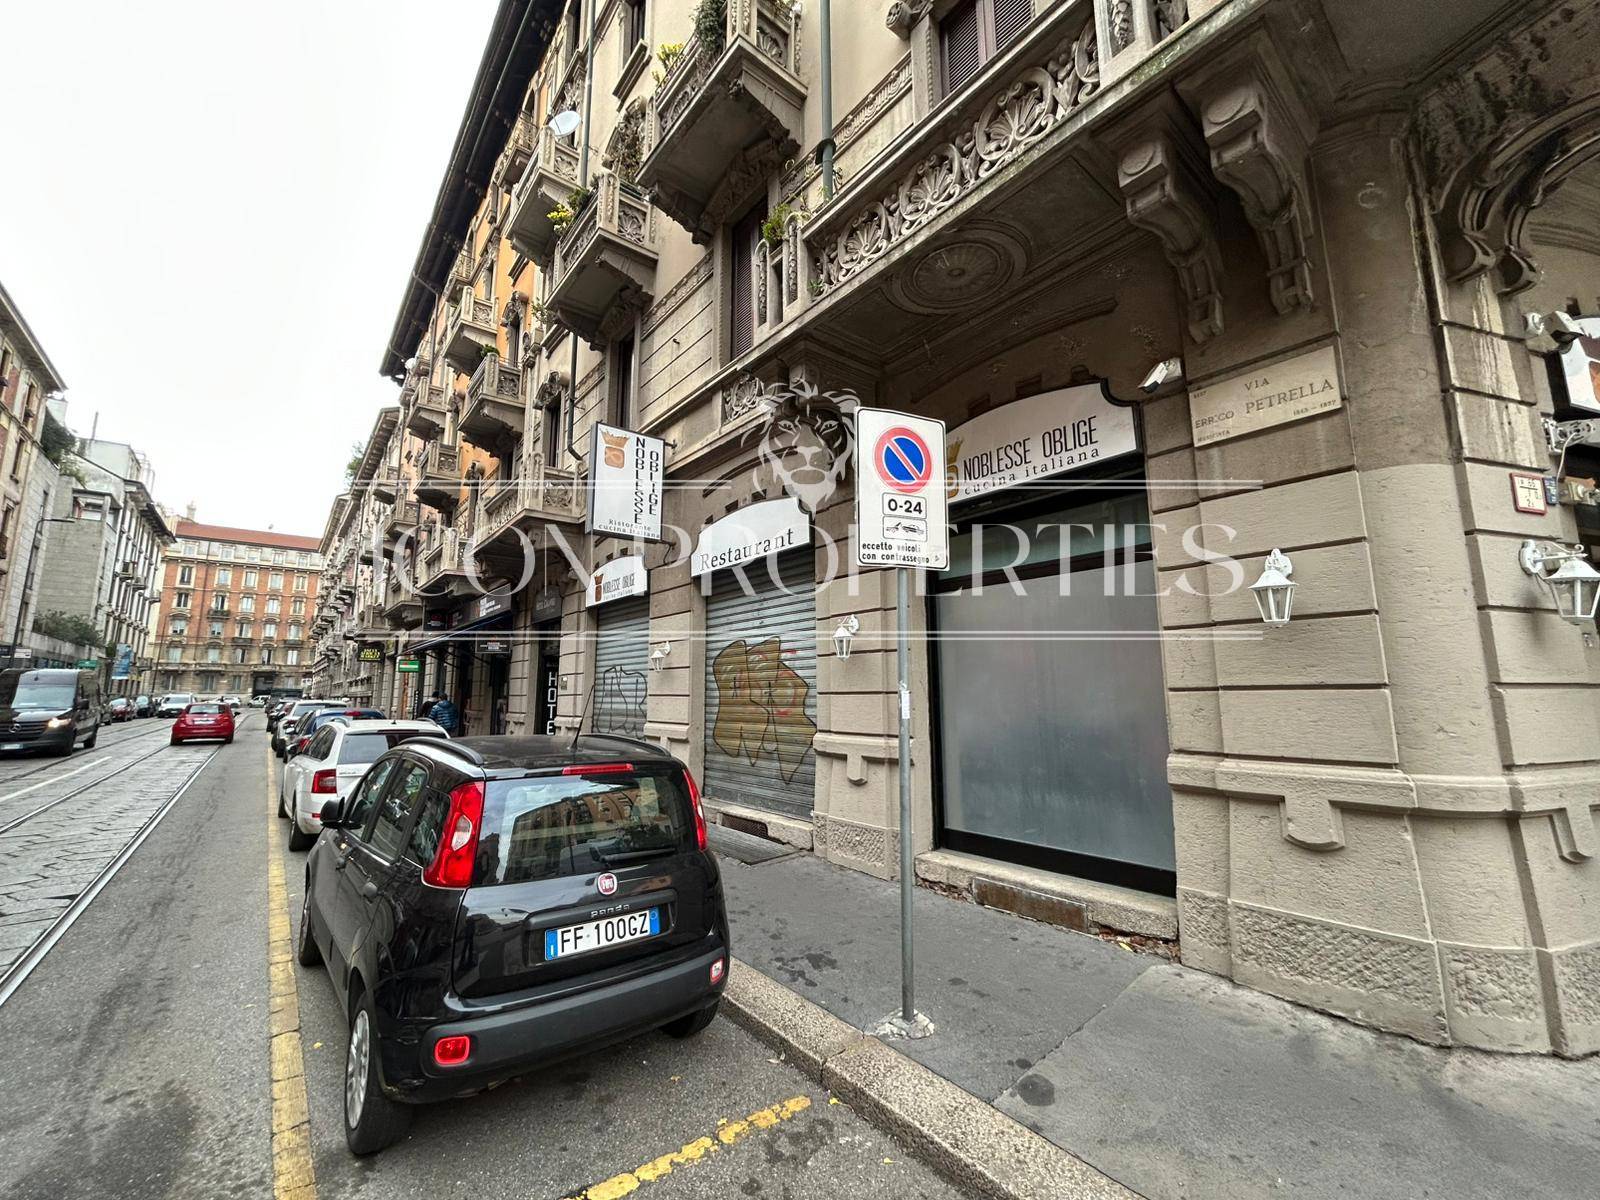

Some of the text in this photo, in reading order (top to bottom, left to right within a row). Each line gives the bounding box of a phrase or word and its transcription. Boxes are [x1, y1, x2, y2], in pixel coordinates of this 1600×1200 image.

[1244, 378, 1270, 391] VIA
[1245, 379, 1334, 414] PETRELLA
[963, 415, 1098, 482] NOBLESSE OBLIGE
[634, 436, 646, 524] NOBLESSE
[649, 450, 659, 516] OBLIGE
[964, 447, 1100, 495] cucina italiana
[887, 498, 923, 514] 0-24
[700, 528, 794, 572] Restaurant
[862, 541, 893, 551] eccetto
[862, 552, 930, 564] con contrassegno
[546, 671, 558, 735] HOTE
